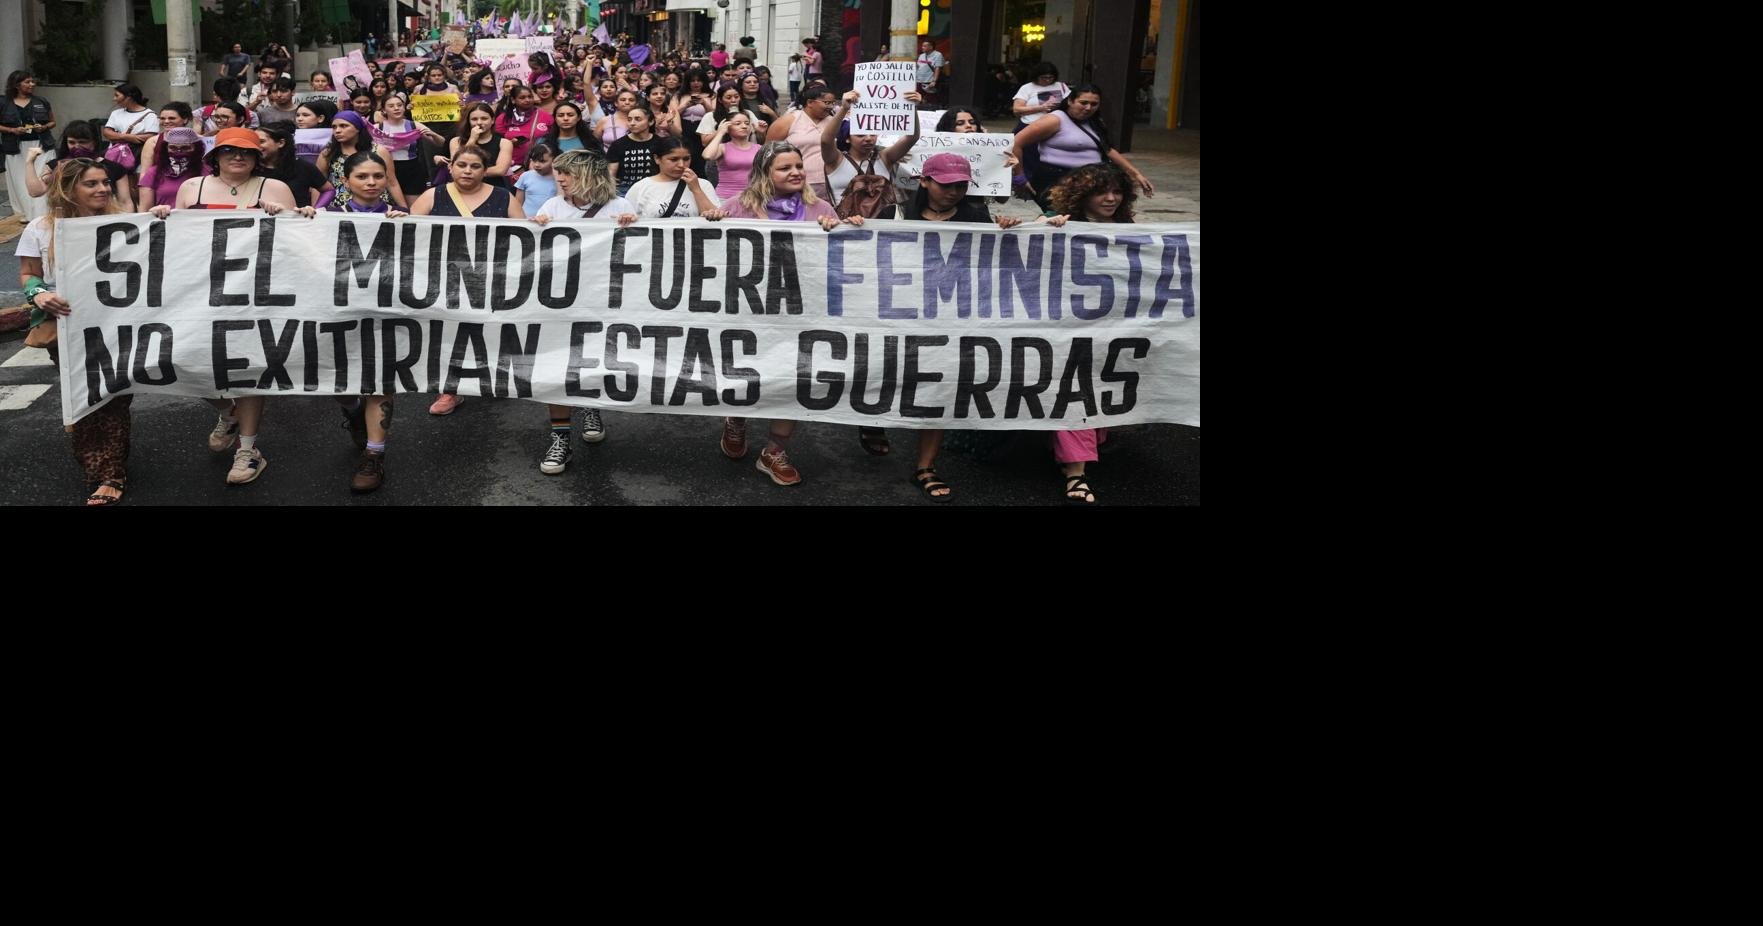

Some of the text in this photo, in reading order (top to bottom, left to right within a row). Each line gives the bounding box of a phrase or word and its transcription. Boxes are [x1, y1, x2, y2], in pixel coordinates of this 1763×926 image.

[906, 63, 914, 71] DE
[867, 72, 915, 82] COSTILLA
[866, 84, 898, 100] VOS
[853, 102, 913, 111] SALISTE DE MI
[856, 114, 910, 131] VIENTRE
[914, 133, 953, 147] STÁS
[624, 148, 651, 156] PUMA
[95, 218, 1196, 321] SI EL MUNDO FUERA FEMINISTA
[83, 317, 1152, 420] NO EXITIRIAN ESTAS GUERRAS
